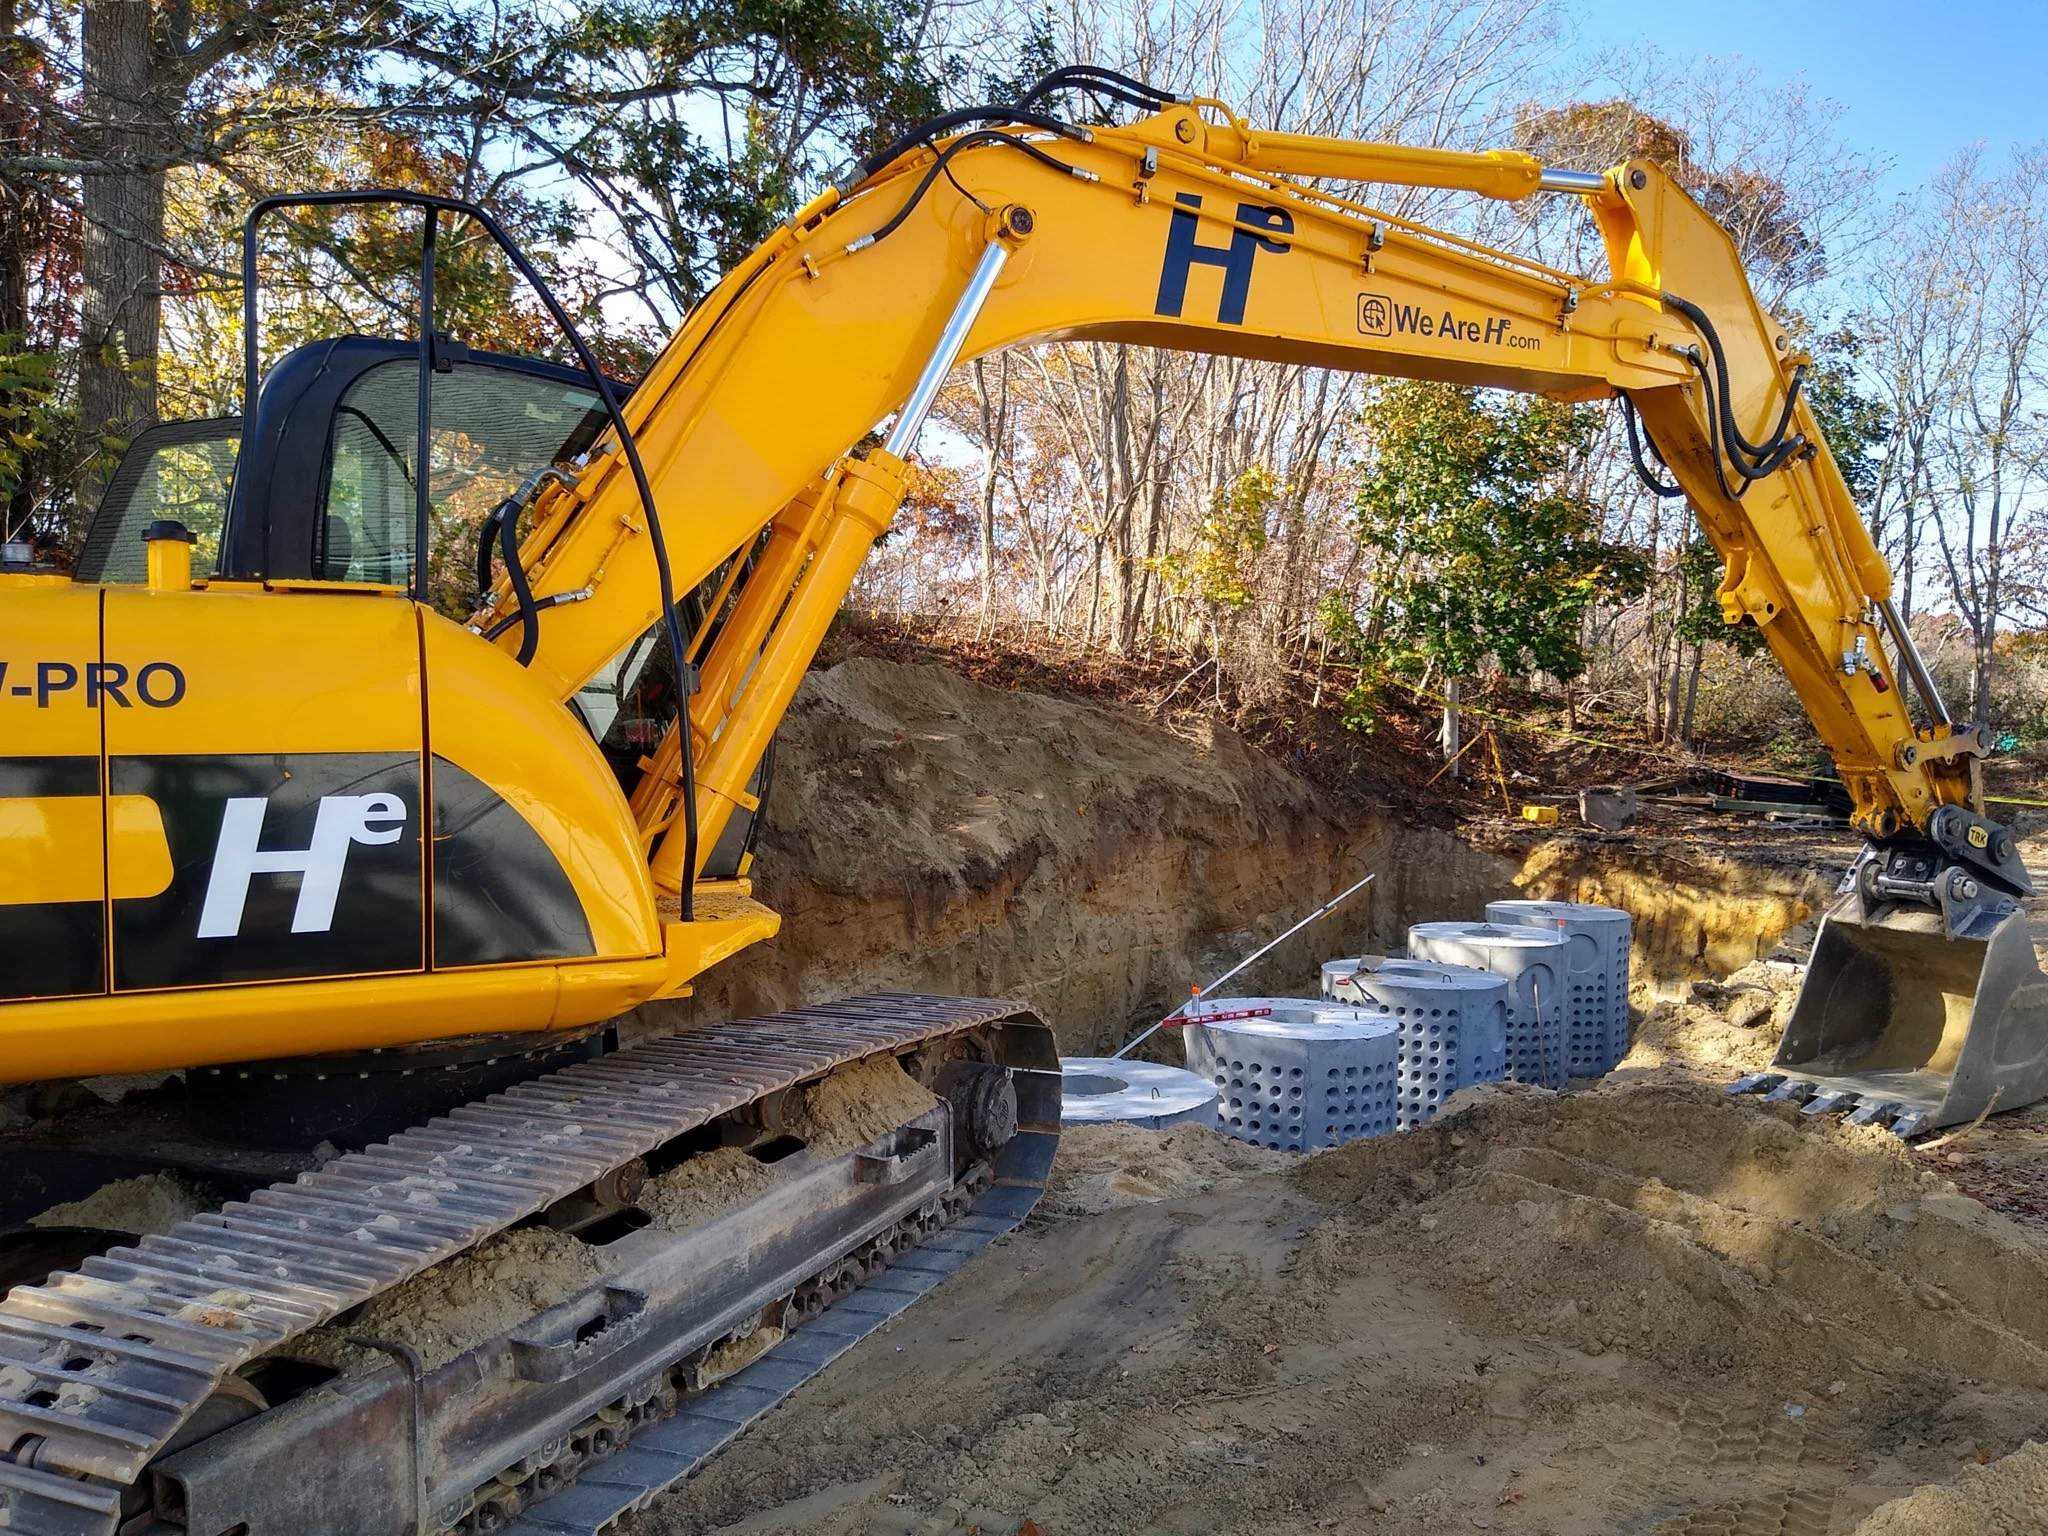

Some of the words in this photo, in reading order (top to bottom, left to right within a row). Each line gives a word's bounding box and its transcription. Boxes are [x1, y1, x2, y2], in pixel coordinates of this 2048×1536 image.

[1394, 303, 1433, 335] We
[1438, 311, 1481, 343] Are
[1971, 829, 1987, 845] TRK
